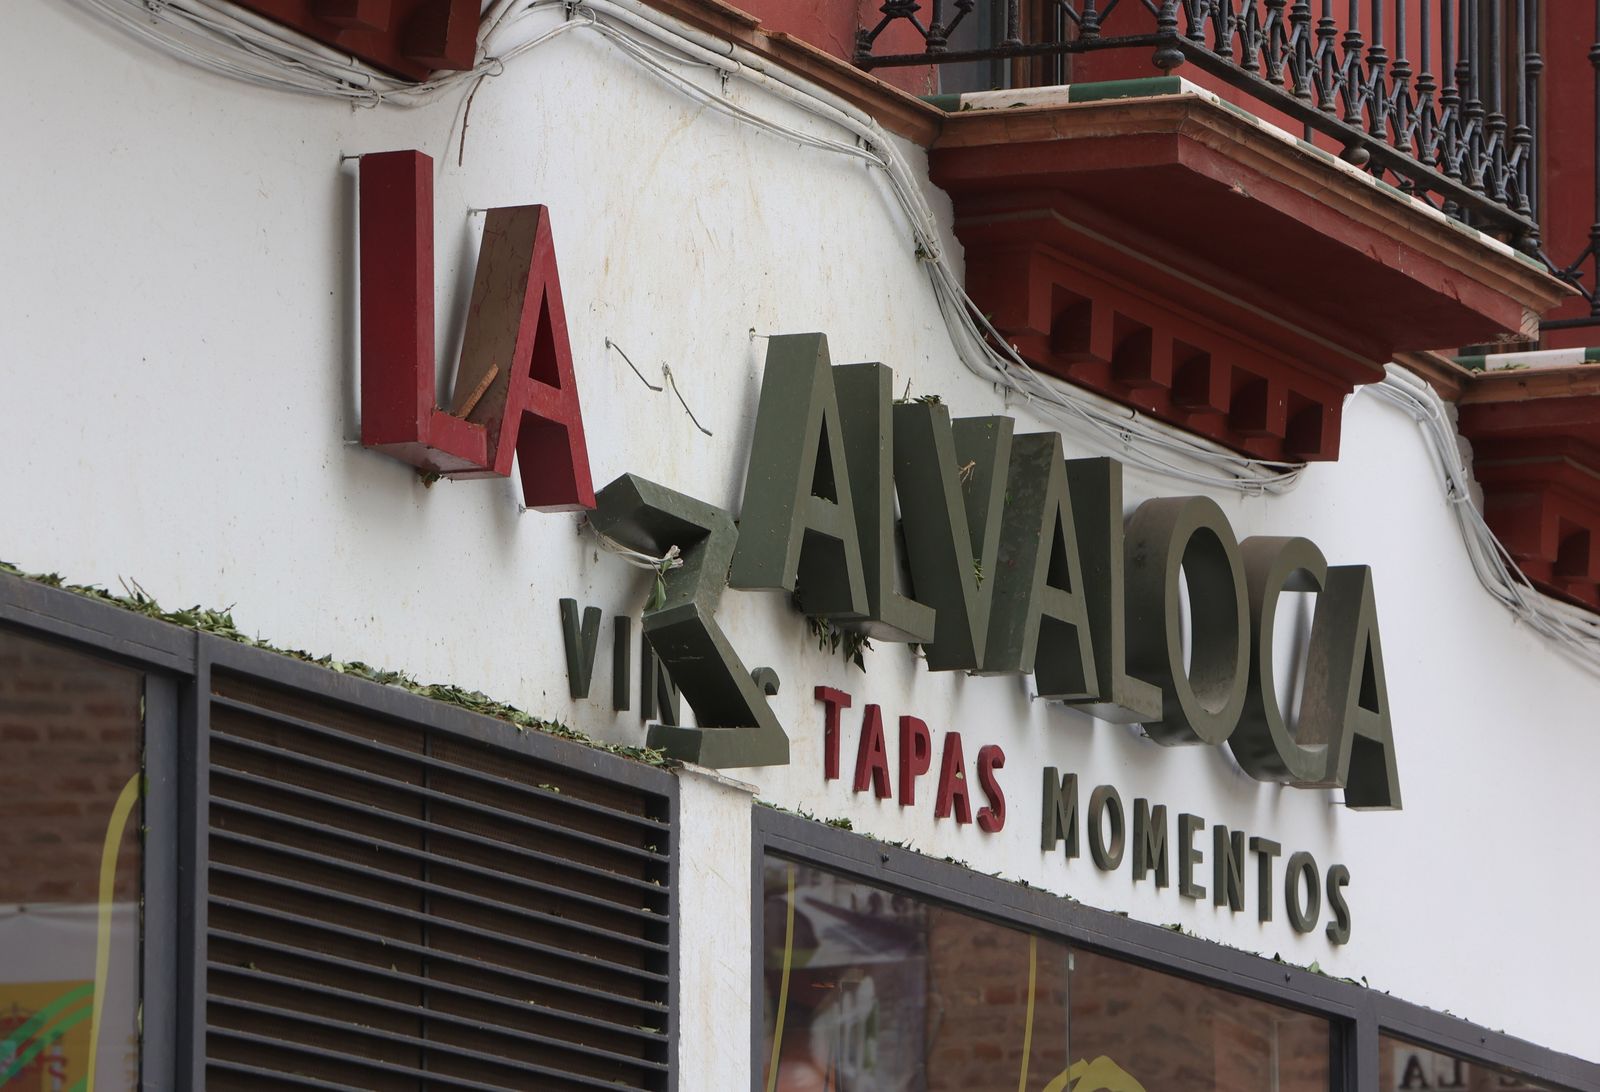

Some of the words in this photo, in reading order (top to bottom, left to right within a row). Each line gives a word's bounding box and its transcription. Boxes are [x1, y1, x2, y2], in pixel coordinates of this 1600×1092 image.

[359, 150, 597, 513] LA
[814, 686, 1006, 832] TAPAS
[1041, 766, 1351, 945] MOMENTOS
